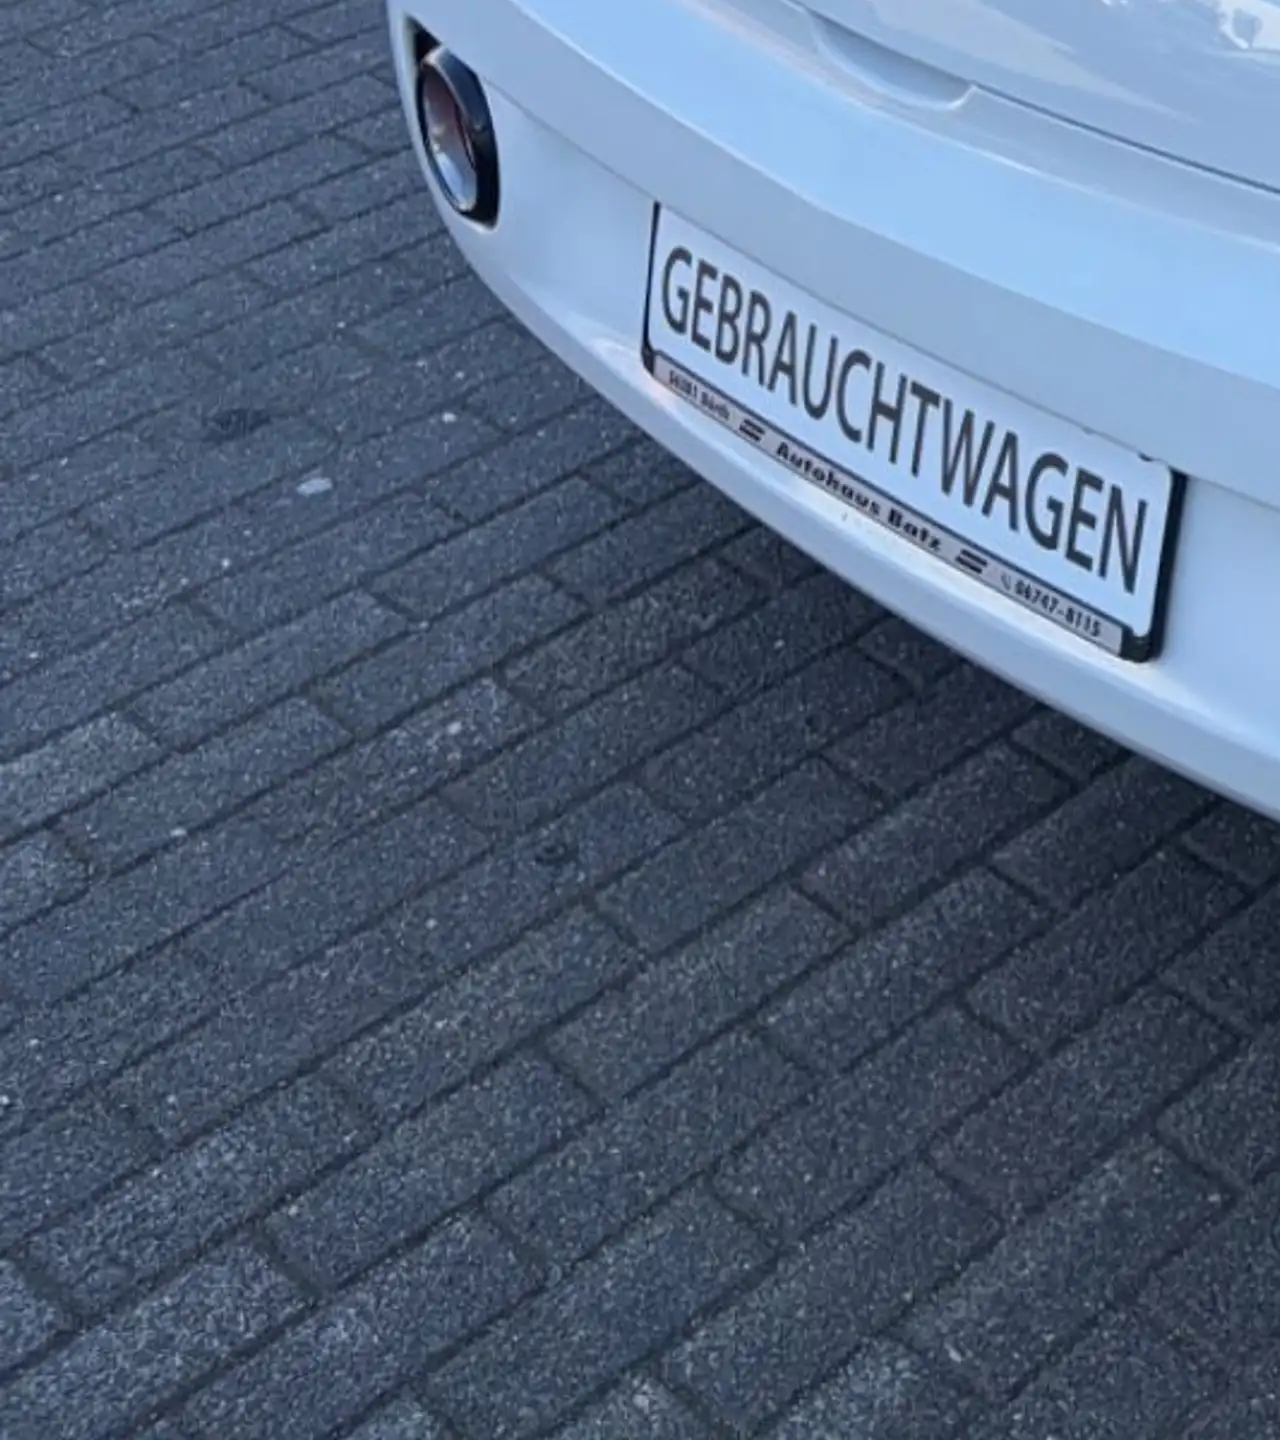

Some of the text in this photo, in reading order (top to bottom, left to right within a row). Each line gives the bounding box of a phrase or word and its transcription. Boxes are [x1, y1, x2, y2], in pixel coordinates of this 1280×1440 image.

[660, 244, 1148, 594] GEBRAUCHTWAGEN
[776, 441, 881, 516] Autohaus
[887, 507, 942, 551] Batz
